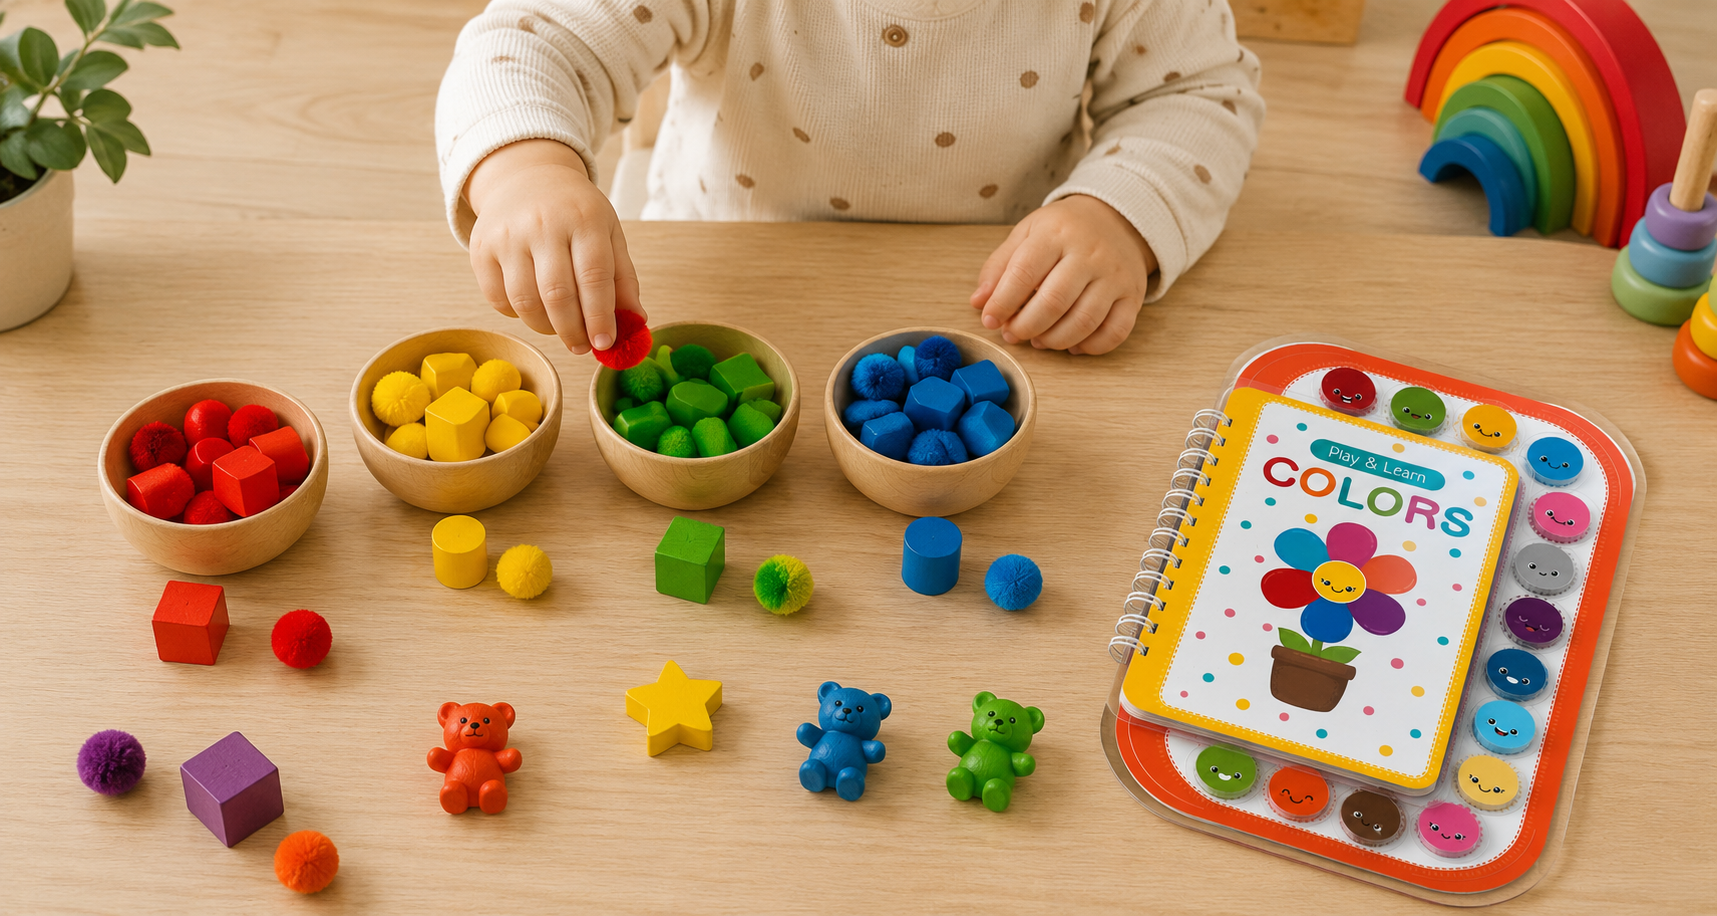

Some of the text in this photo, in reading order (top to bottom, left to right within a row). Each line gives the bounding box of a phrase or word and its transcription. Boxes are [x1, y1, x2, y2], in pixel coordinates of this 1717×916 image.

[1328, 445, 1427, 484] Play & Learn
[1263, 456, 1474, 538] COLORS
